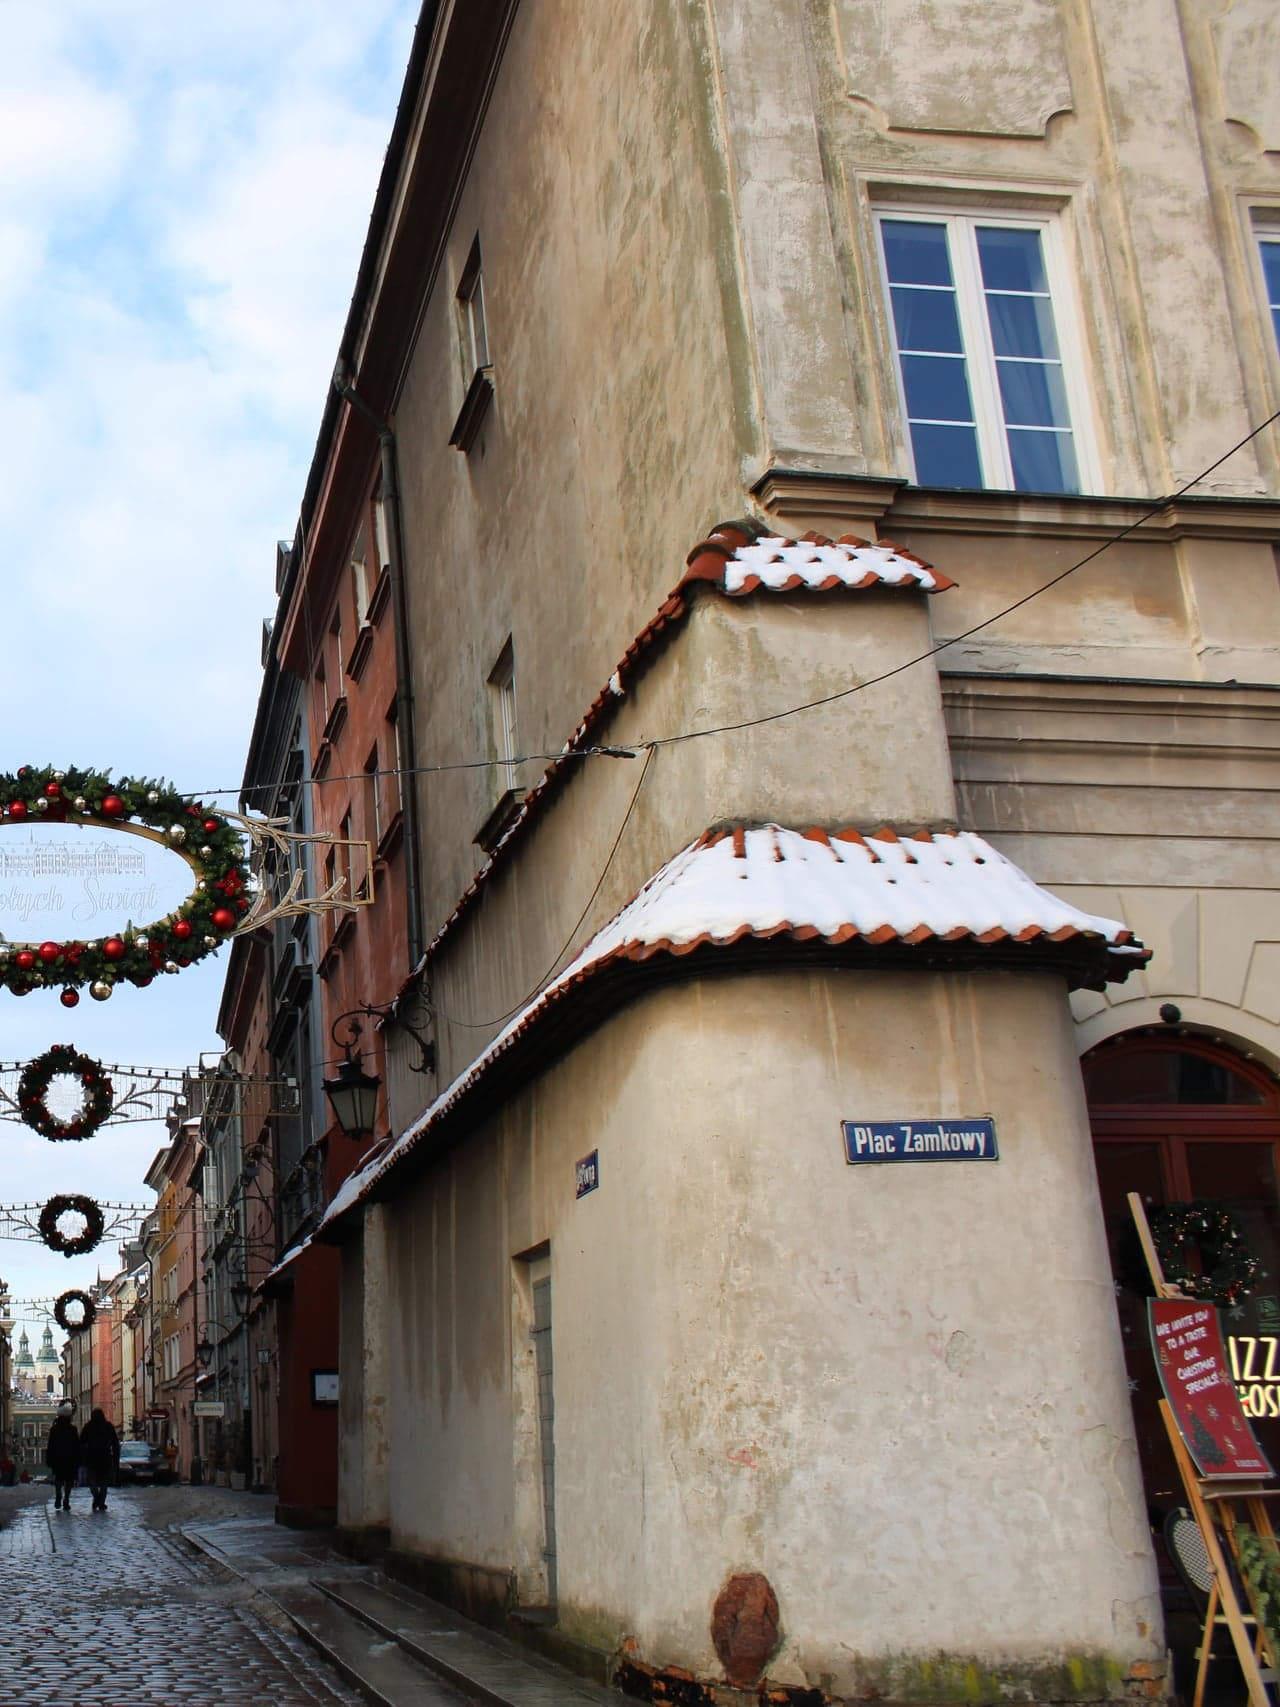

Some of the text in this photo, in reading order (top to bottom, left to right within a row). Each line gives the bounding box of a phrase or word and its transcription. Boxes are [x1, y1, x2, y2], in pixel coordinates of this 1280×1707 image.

[854, 1125, 986, 1156] Plac Zamkowy
[1156, 1309, 1209, 1336] WE INVITE YOU
[1165, 1327, 1208, 1350] TO A TASTE
[1184, 1347, 1200, 1360] OUR
